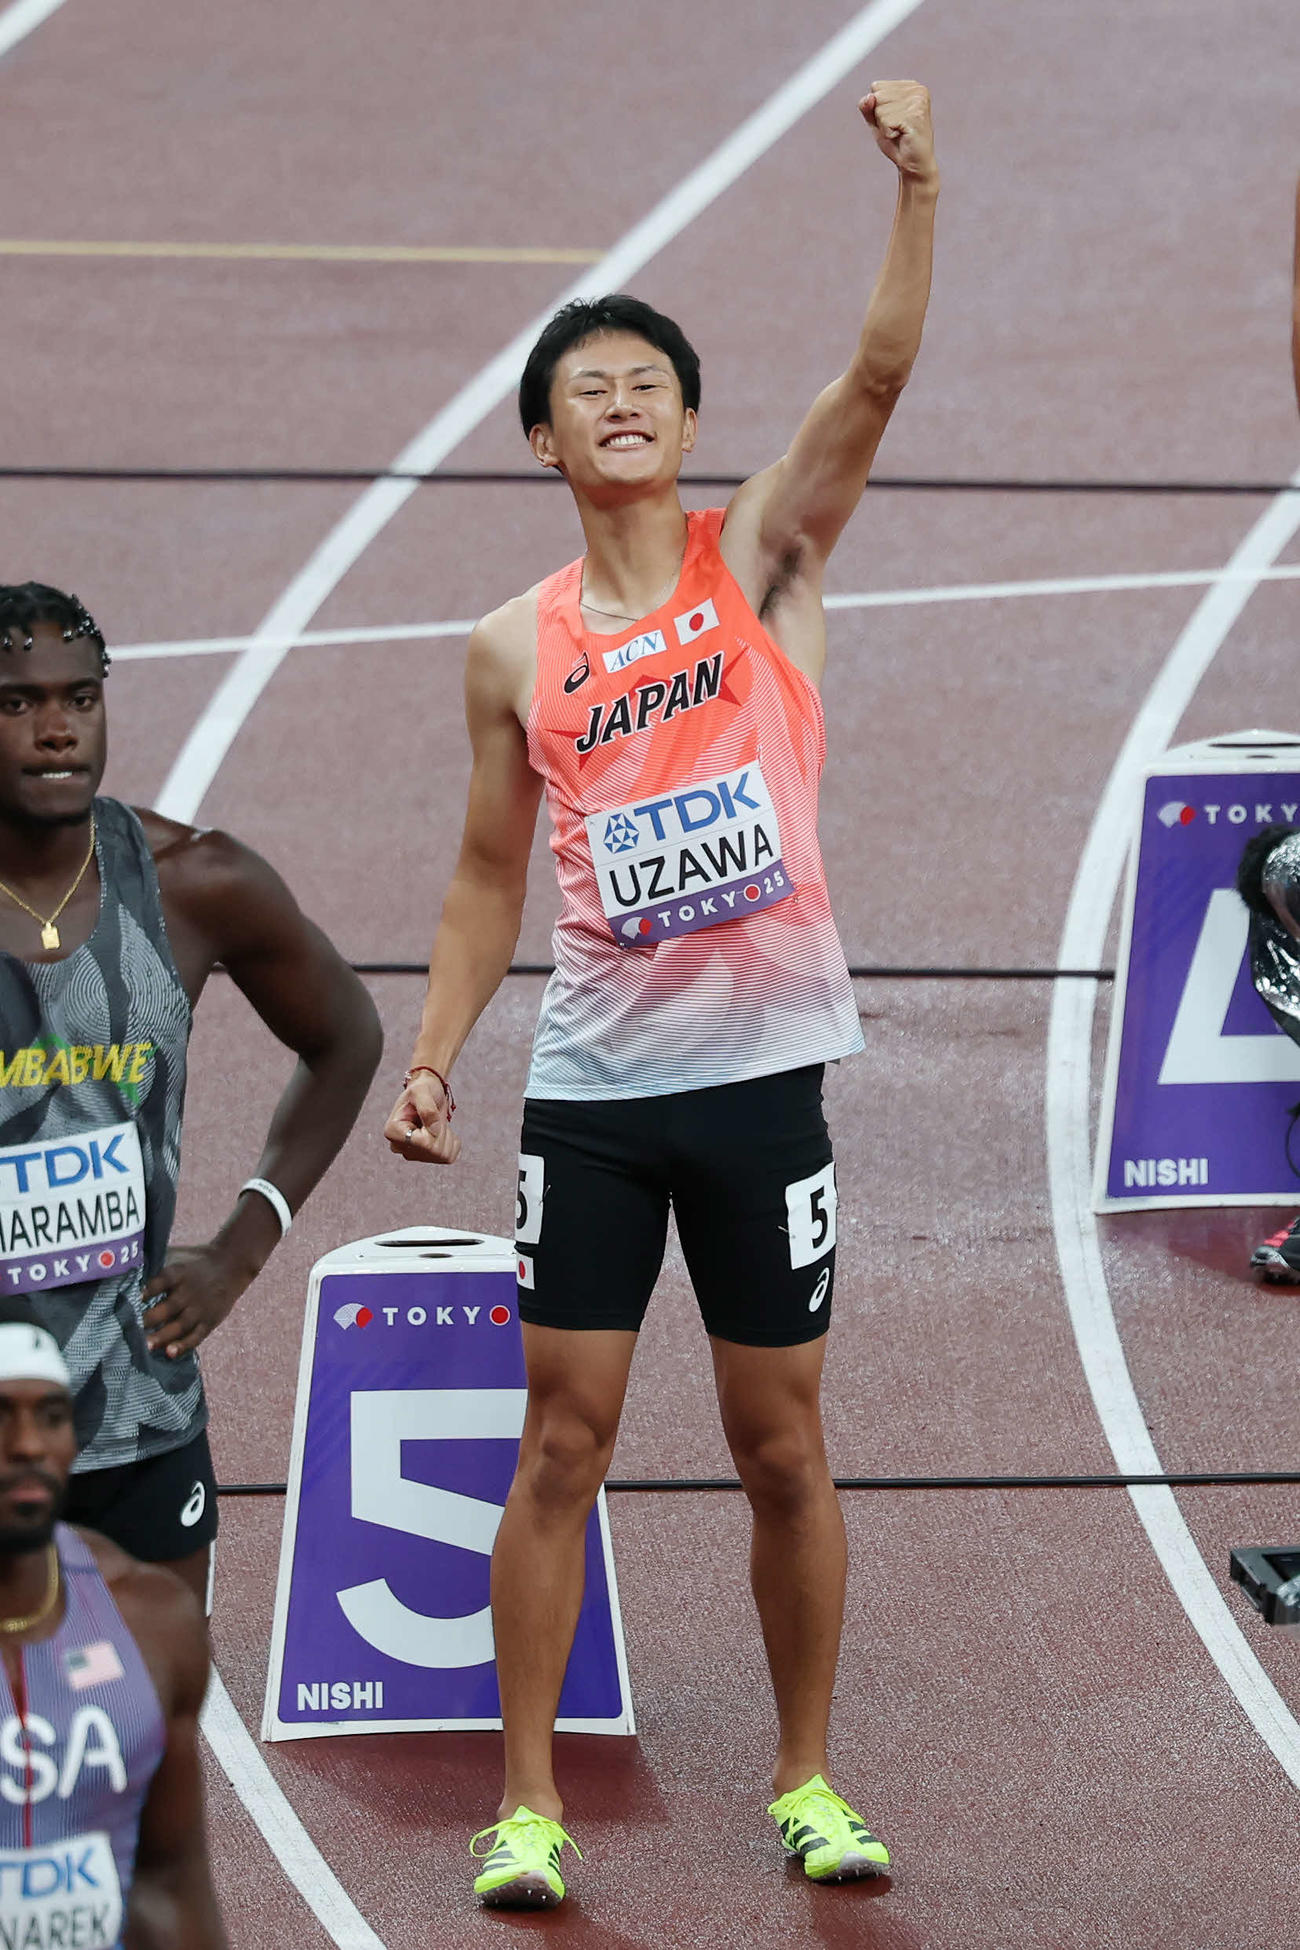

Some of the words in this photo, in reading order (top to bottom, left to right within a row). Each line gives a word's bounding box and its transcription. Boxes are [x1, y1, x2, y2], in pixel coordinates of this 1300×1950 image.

[610, 632, 660, 671] ACN
[576, 652, 724, 753] JAPAN
[634, 771, 760, 841] TDK
[609, 824, 774, 907] UZAWA
[764, 873, 785, 893] 25
[0, 1133, 129, 1194] TDK
[1124, 1159, 1208, 1187] NISHI
[810, 1185, 829, 1249] 5
[120, 1241, 138, 1263] 25
[336, 1389, 528, 1668] 5
[297, 1681, 383, 1710] NISHI
